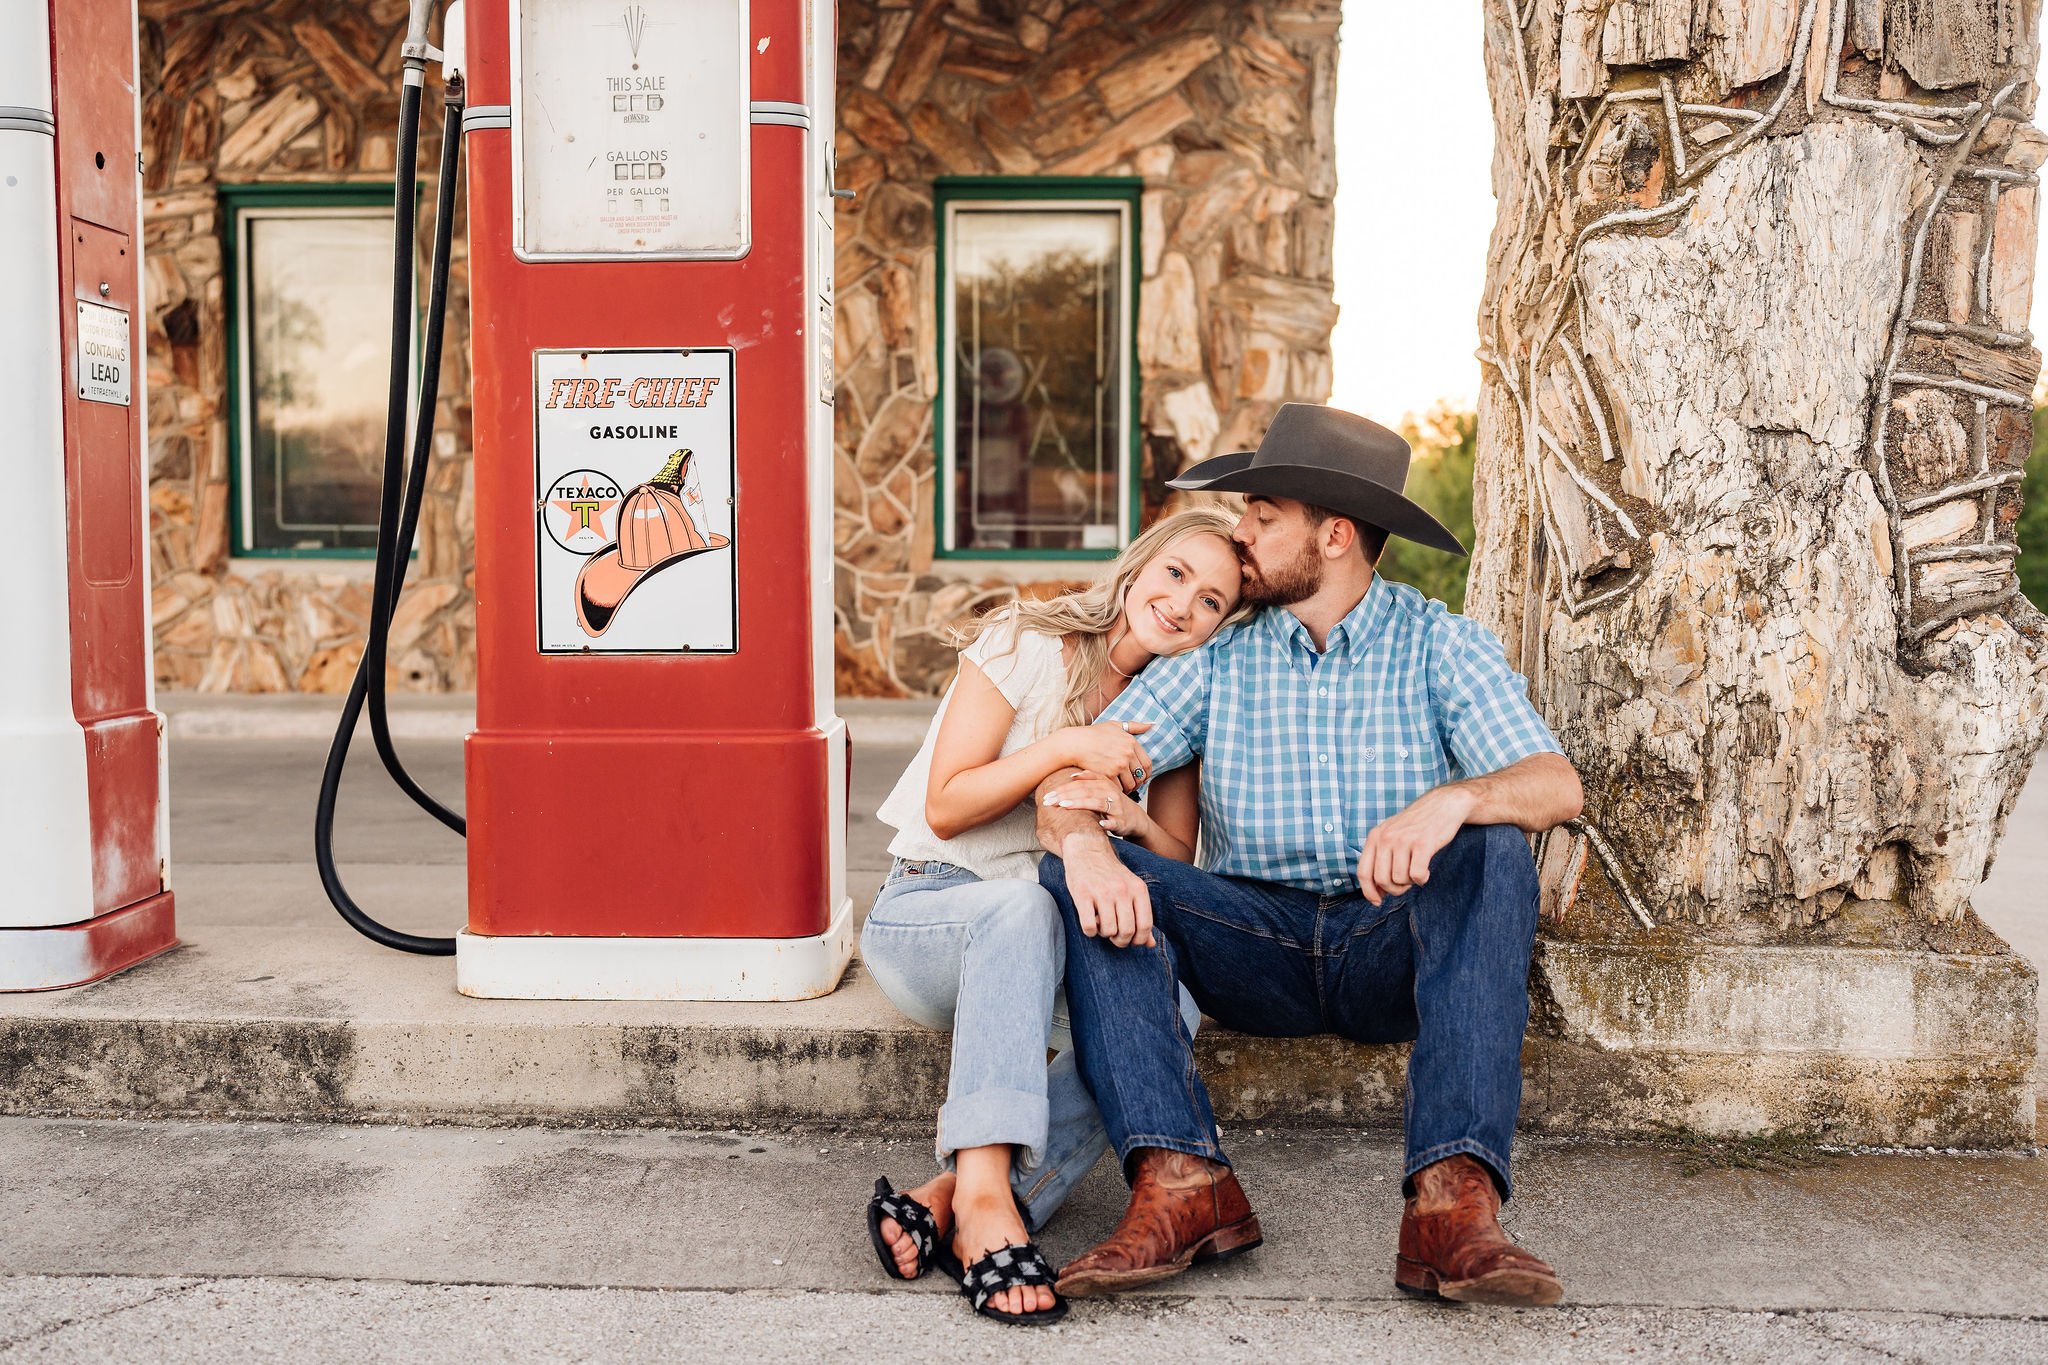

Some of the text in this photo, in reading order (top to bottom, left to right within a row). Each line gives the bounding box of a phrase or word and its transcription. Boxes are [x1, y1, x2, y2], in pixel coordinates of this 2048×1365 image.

[606, 76, 665, 92] THIS SALE
[606, 150, 668, 162] GALLONS
[607, 187, 669, 196] PER GALLON
[85, 341, 125, 362] CONTAINS
[91, 362, 119, 383] LEAD
[545, 377, 720, 409] FIRE-CHIEF
[589, 425, 678, 440] GASOLINE
[556, 487, 617, 499] TEXACO
[571, 501, 599, 529] T
